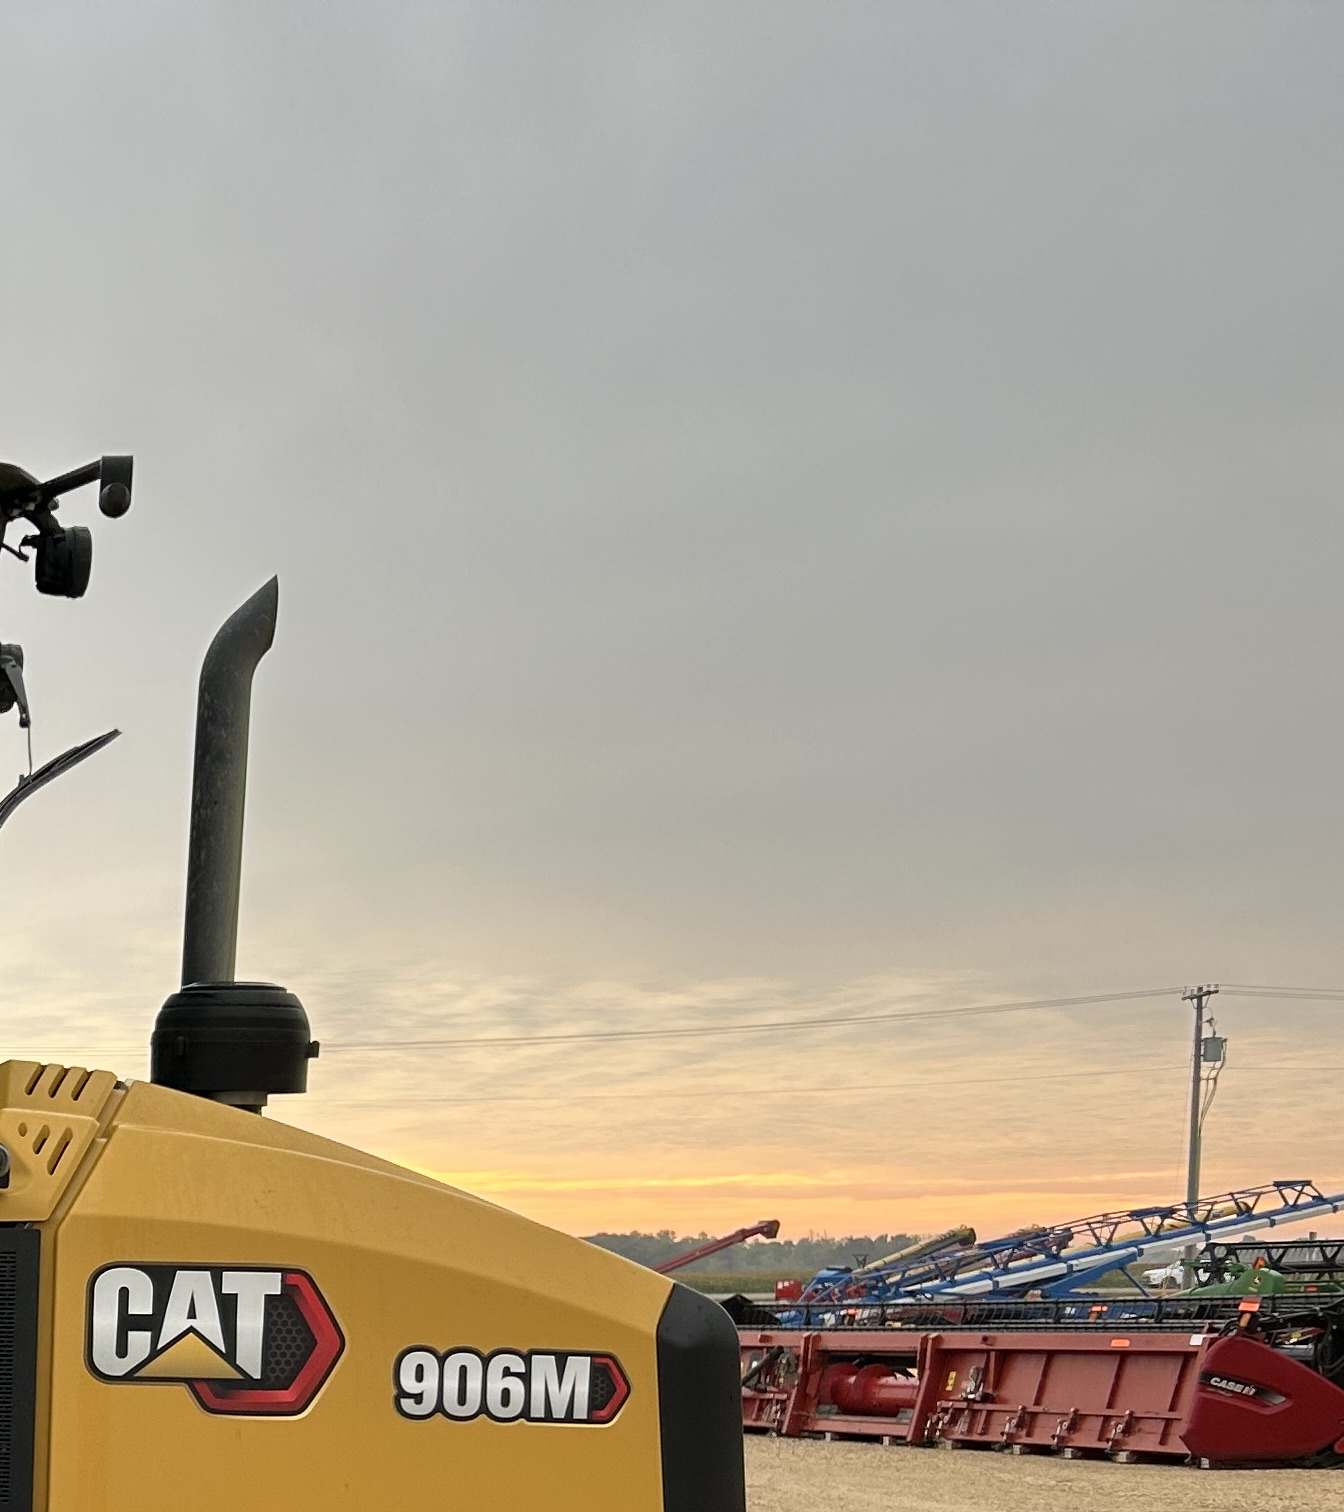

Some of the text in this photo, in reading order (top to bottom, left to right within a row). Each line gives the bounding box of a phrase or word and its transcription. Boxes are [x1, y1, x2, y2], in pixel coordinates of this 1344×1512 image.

[91, 1266, 283, 1381] CAT
[398, 1351, 593, 1421] 906M
[1210, 1377, 1244, 1393] CASE
